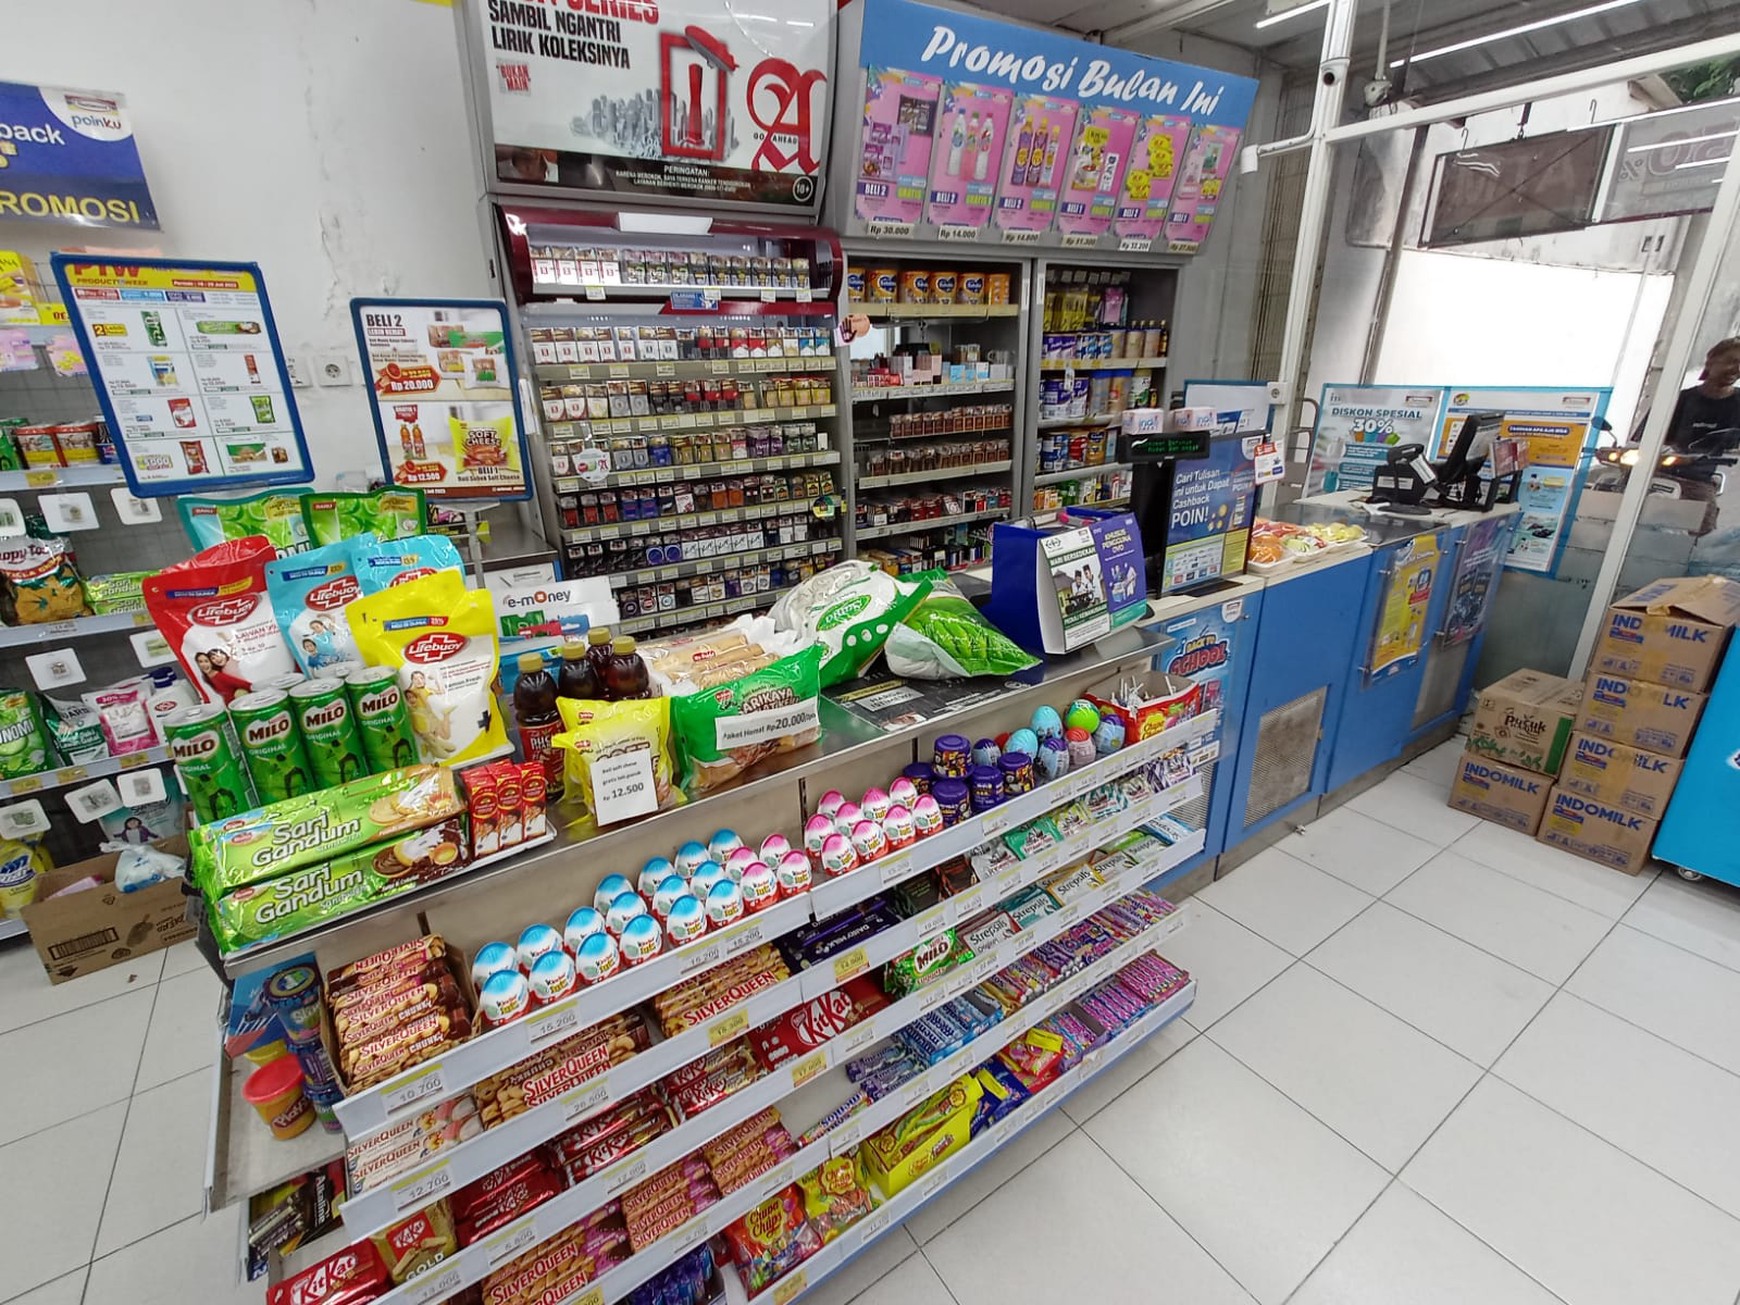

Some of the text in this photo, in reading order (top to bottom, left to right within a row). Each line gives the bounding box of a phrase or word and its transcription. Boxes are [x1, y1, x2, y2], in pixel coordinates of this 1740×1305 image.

[488, 0, 622, 43] SAMBIL NGANTRI
[492, 26, 631, 69] LIRIK KOLEKSINYA
[921, 26, 1225, 116] Promosi Bulan Ini
[664, 165, 710, 177] PERINGATAN:
[0, 191, 141, 224] ROMOSI
[870, 225, 881, 235] Rp
[366, 314, 403, 327] BELI 2
[1332, 407, 1422, 418] DISKON SPESIAL
[1353, 418, 1393, 433] 30%
[468, 431, 497, 439] SOFT
[1171, 507, 1209, 529] POIN!
[1173, 494, 1210, 511] Cashback
[197, 599, 254, 619] Lifebuoy
[310, 585, 362, 602] Lifebuoy
[507, 590, 571, 608] e-money
[1611, 613, 1708, 643] INDILK
[408, 641, 463, 655] Lifebuoy
[1170, 641, 1227, 677] SCHOOL
[362, 692, 399, 714] MILO
[1597, 678, 1690, 710] INDLK
[249, 718, 290, 742] MILO
[306, 705, 345, 727] MILO
[173, 738, 216, 758] MILO
[1578, 738, 1671, 774] INDILK
[611, 782, 645, 799] 12.500
[1465, 762, 1541, 795] INDOMILK
[272, 809, 330, 845] Sari
[1555, 793, 1644, 831] INDOMILK
[251, 817, 362, 867] Gandum
[273, 862, 331, 899] Sari
[1057, 869, 1091, 896] Strepsils
[255, 869, 363, 925] Gandum
[1013, 896, 1050, 922] Strepsils
[970, 915, 1009, 945] Strepsils
[916, 942, 949, 970] MILO
[346, 966, 419, 1002] SILVERQUEEN
[681, 970, 776, 1028] SILVERQUEEN
[350, 985, 427, 1026] SILVERQUEEN
[799, 990, 851, 1044] KitKat
[360, 1019, 439, 1058] SILVERQUEEN
[409, 1033, 444, 1054] CHUNKY
[523, 1043, 611, 1101] SILVERQUEEN
[348, 1119, 414, 1158] SILVERQUEEN
[714, 1110, 774, 1157] SILVERQUEEN
[353, 1138, 421, 1182] SILVERQUEEN
[624, 1170, 681, 1211] SILVERQUEEN
[629, 1194, 686, 1235] SILVERQUEEN
[749, 1200, 780, 1223] Chupa
[752, 1210, 783, 1238] Chups
[394, 1217, 426, 1250] KitKat
[633, 1207, 691, 1249] SILVERQUEEN
[291, 1252, 358, 1305] KitKat
[407, 1253, 446, 1281] GOLD
[489, 1243, 579, 1305] SILVERQUEEN
